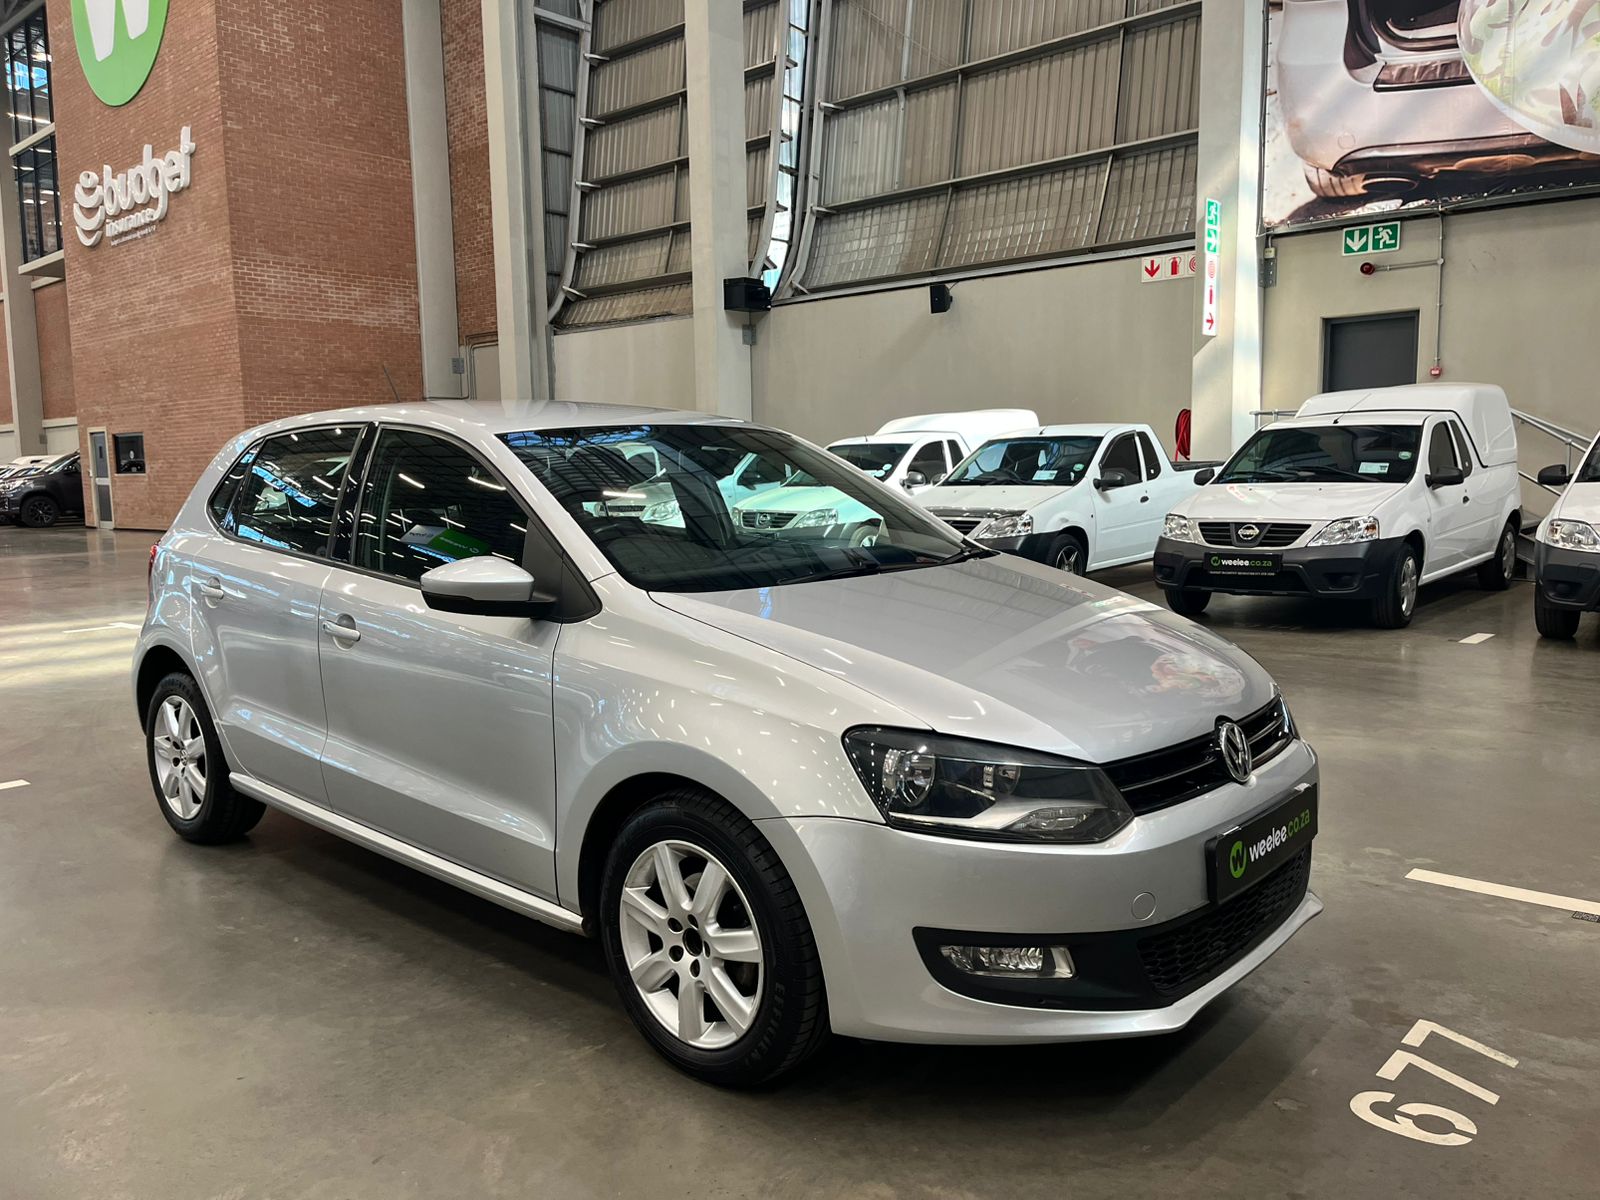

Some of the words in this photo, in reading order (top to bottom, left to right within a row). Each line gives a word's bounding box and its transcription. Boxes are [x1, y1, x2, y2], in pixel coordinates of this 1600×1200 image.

[102, 125, 196, 222] budget
[1221, 558, 1272, 567] weelee.co.za
[1248, 808, 1310, 863] weelee.co.za
[1349, 1018, 1519, 1147] 677
